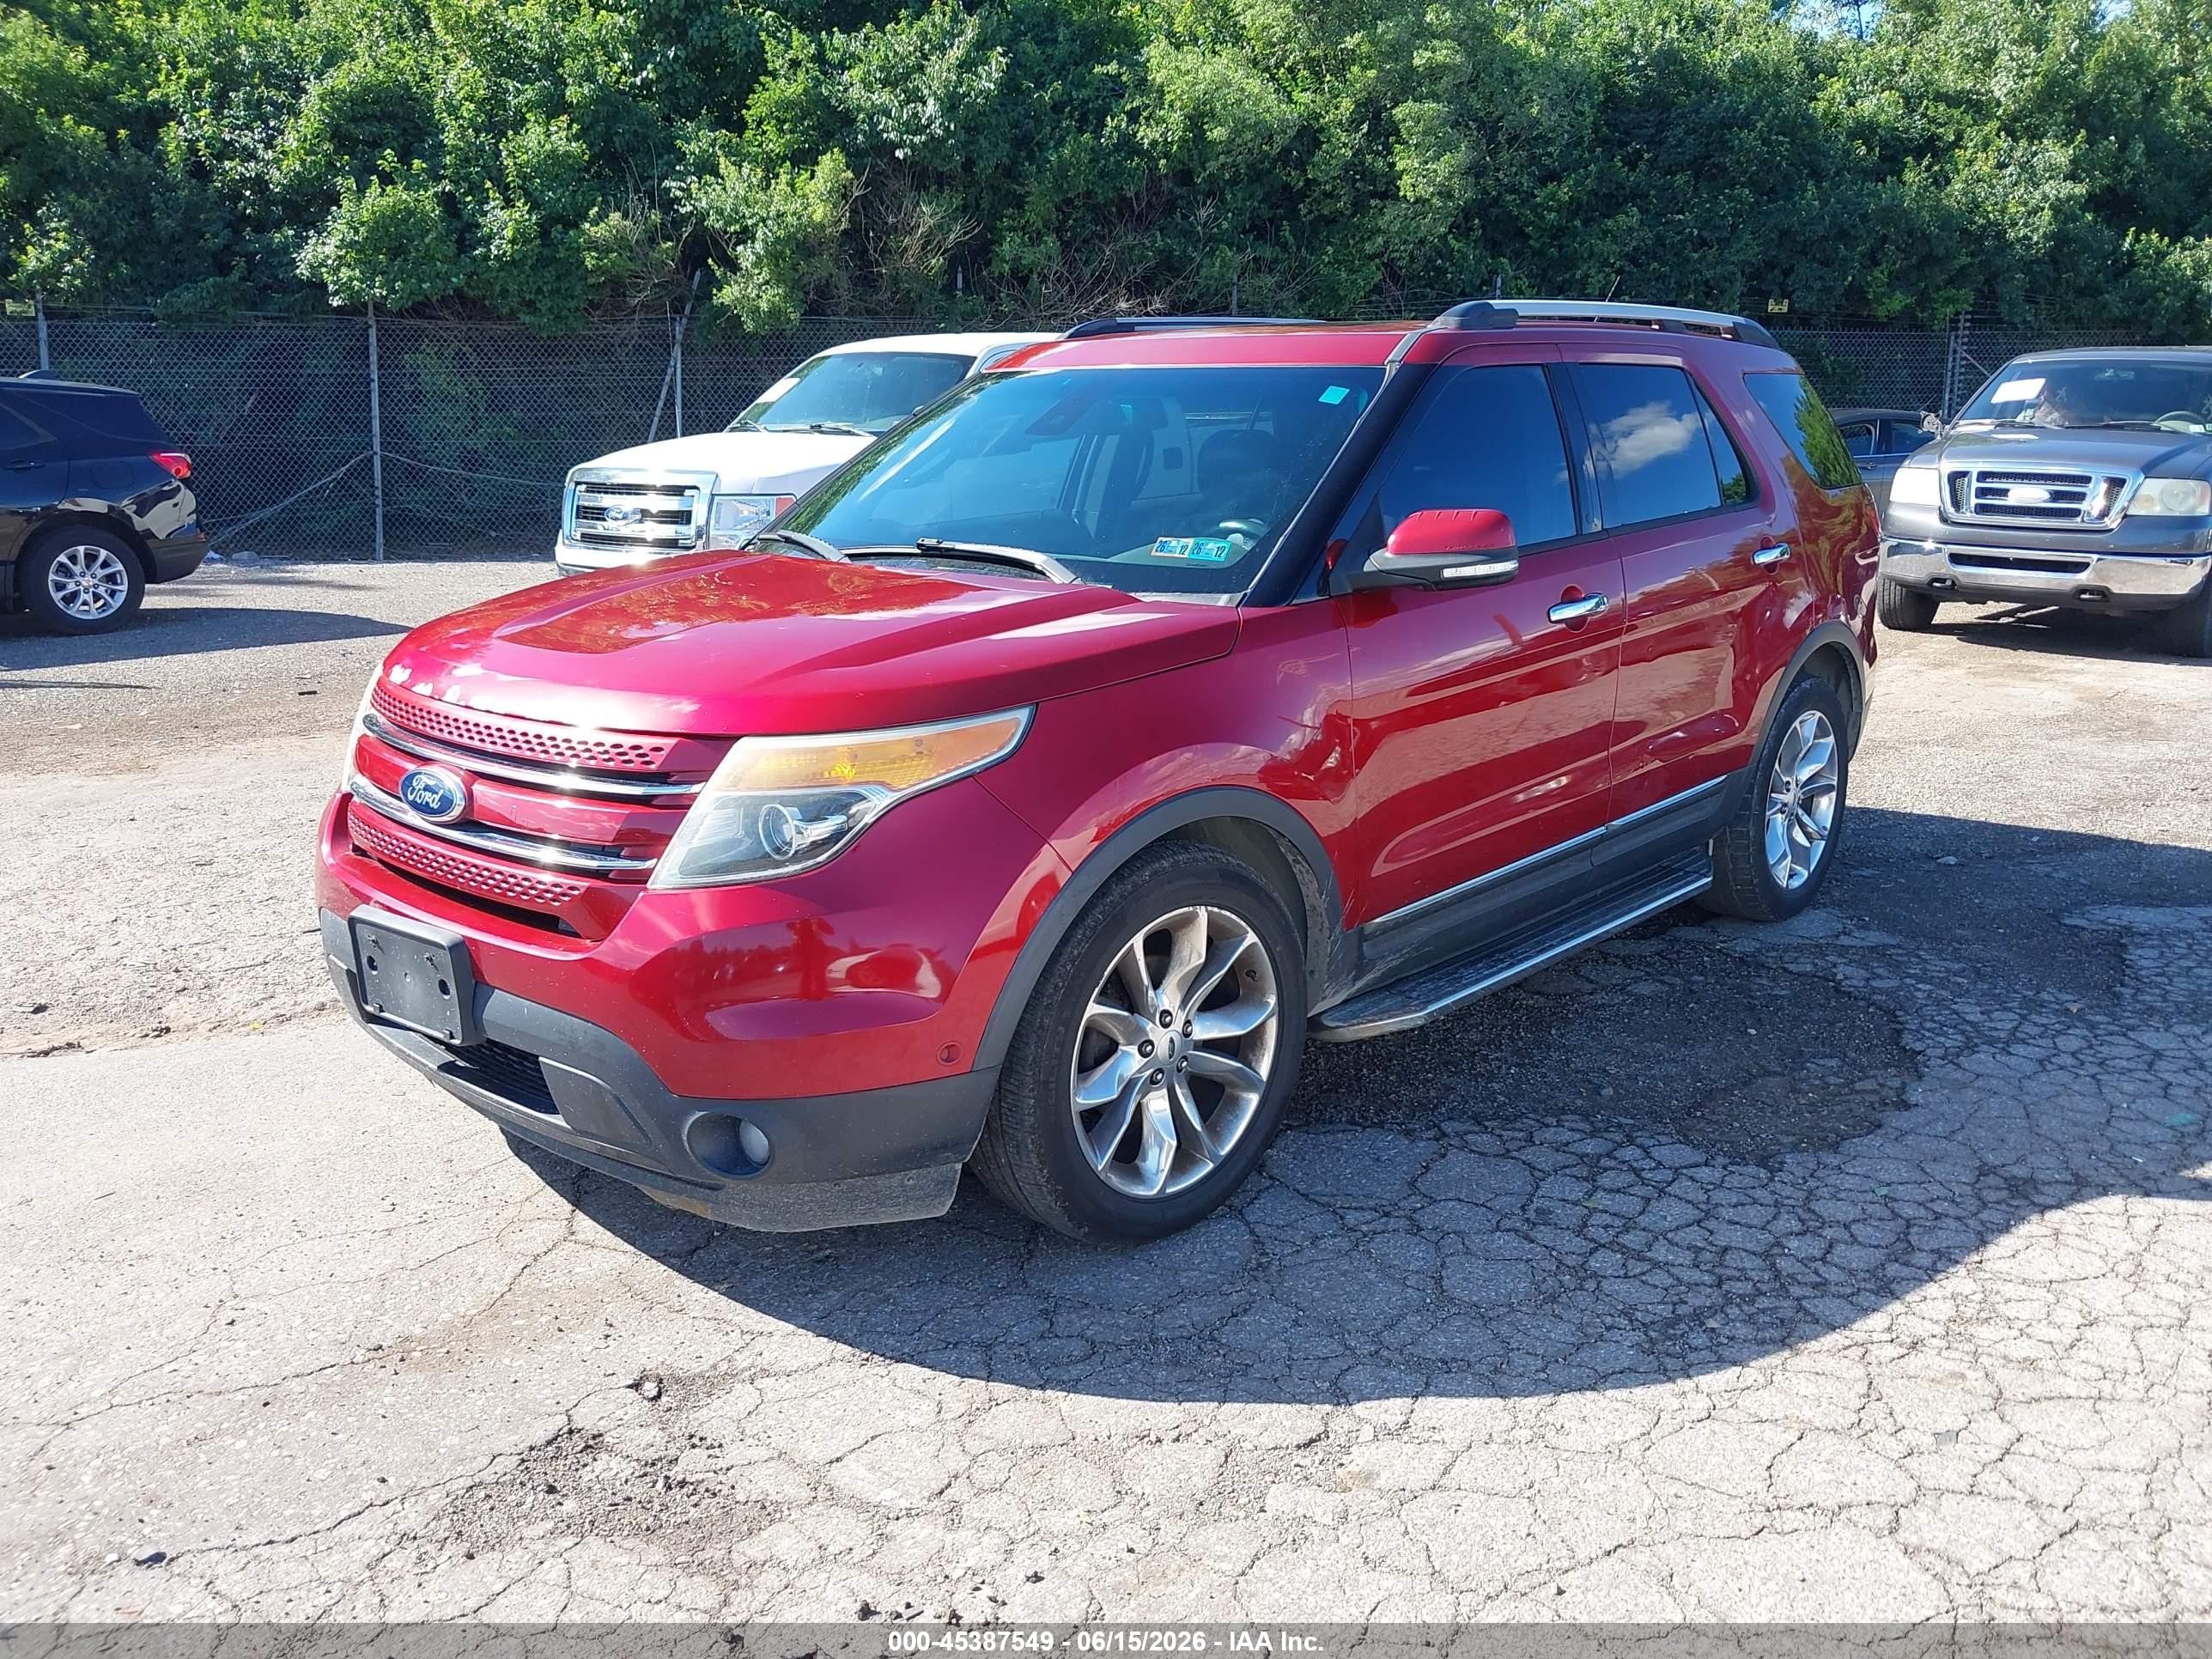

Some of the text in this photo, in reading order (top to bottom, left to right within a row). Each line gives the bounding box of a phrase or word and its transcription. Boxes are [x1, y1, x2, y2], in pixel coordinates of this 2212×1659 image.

[1155, 539, 1188, 556] 26 12
[1191, 542, 1226, 558] 26 12
[407, 775, 444, 809] Ford
